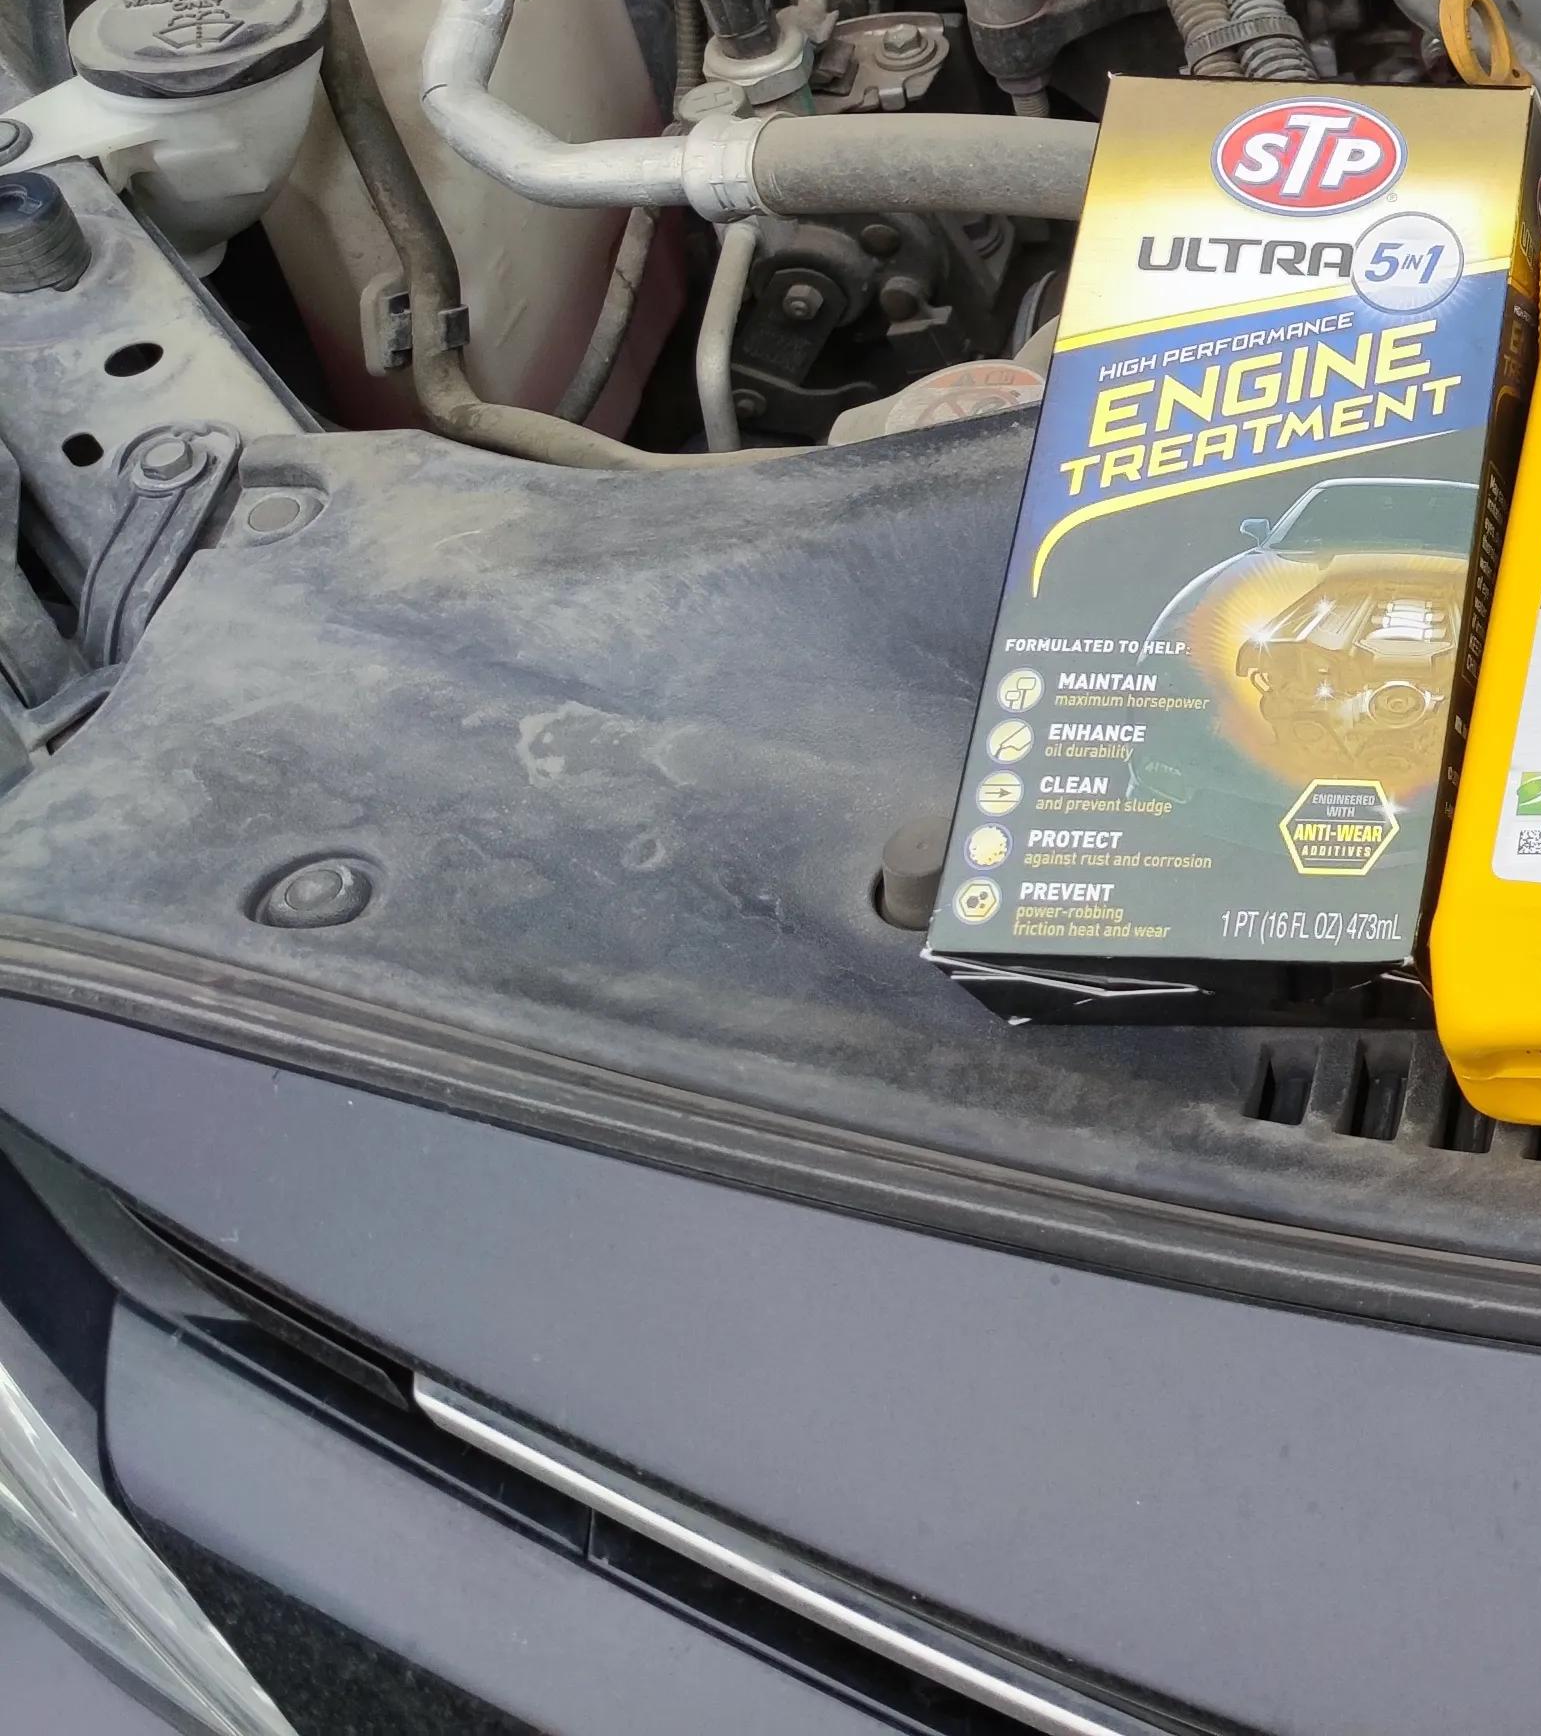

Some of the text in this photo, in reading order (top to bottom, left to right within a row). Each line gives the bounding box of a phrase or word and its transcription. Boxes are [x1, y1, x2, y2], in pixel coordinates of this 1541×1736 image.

[1234, 114, 1383, 196] STP
[1137, 236, 1354, 278] ULTRA
[1098, 311, 1355, 381] HIGH PERFORMANCE
[1088, 321, 1438, 448] ENGINE
[1060, 375, 1462, 496] TREATMENT
[1005, 638, 1114, 654] FORMULATED
[1119, 640, 1139, 654] TO
[1058, 673, 1158, 692] MAINTAIN
[1054, 693, 1210, 712] maximum horsepower
[1048, 723, 1147, 743] ENHANCE
[1044, 744, 1135, 762] oil durability
[1040, 776, 1109, 794] CLEAN
[1035, 797, 1173, 816] and prevent sludge
[1312, 794, 1376, 806] ENGINEERED
[1326, 806, 1356, 817] WITH
[1028, 829, 1123, 849] PROTECT
[1293, 823, 1383, 842] ANTI-WEAR
[1024, 851, 1213, 869] against rust and corrosion
[1301, 845, 1372, 857] ADDITIVES
[1020, 882, 1115, 902] PREVENT
[1015, 905, 1124, 922] power-robbing
[1013, 920, 1171, 939] friction heat and wear
[1221, 911, 1230, 937] 1
[1233, 912, 1259, 938] PT
[1290, 912, 1309, 939] FL
[1346, 913, 1402, 940] 473mL
